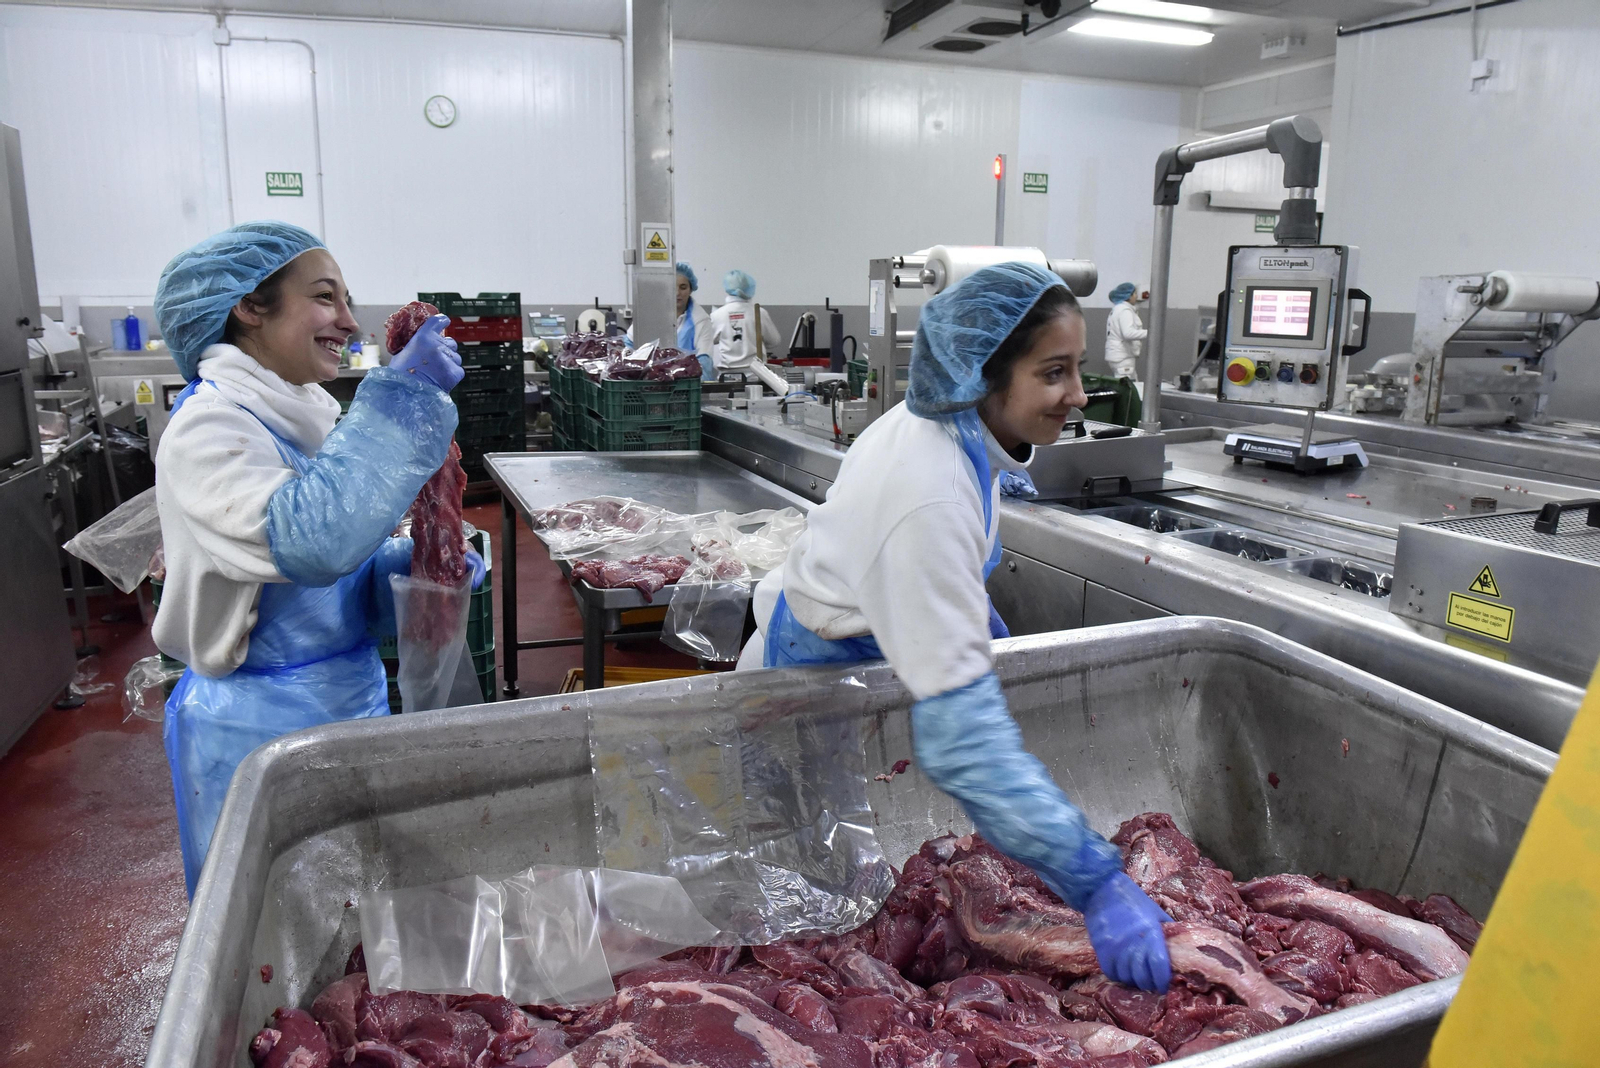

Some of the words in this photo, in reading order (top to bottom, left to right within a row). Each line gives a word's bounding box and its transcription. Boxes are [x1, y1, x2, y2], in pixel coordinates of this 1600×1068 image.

[267, 173, 302, 188] SALIDA
[1024, 174, 1047, 186] SALIDA
[1256, 215, 1275, 227] SALIDA
[1460, 606, 1482, 615] introducir
[1490, 614, 1506, 622] manos
[1465, 614, 1481, 622] debajo
